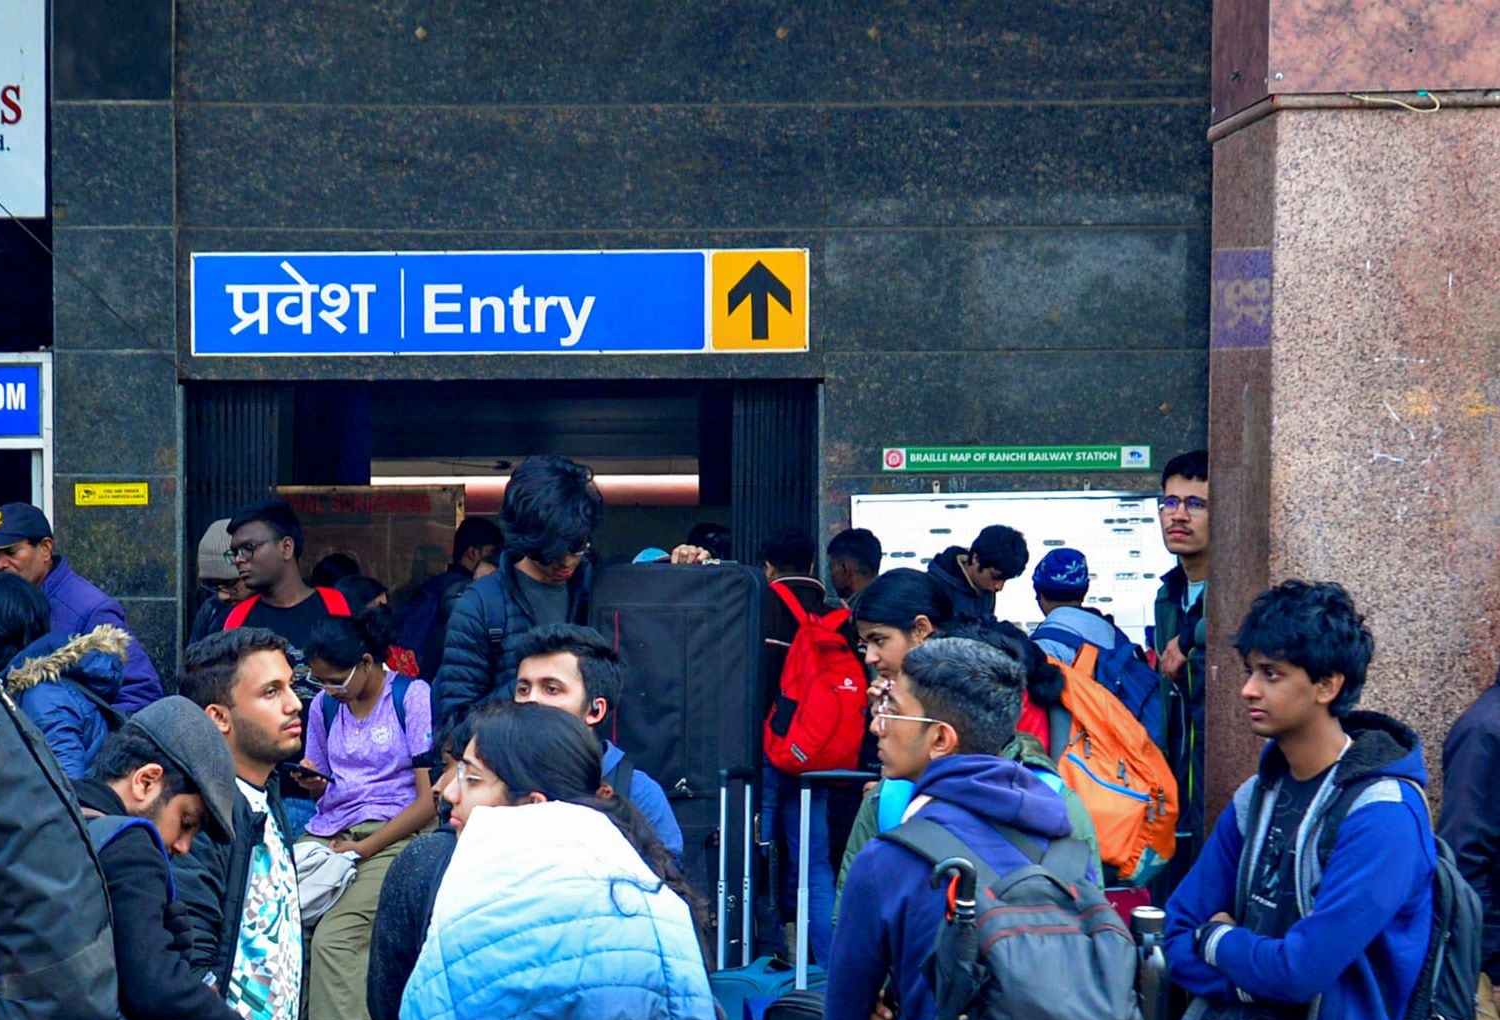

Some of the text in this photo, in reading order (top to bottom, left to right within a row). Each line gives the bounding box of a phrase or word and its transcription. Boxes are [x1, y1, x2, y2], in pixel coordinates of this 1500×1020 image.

[226, 261, 377, 335] प्रवेश
[423, 283, 596, 346] Entry
[910, 451, 1118, 463] BRAILLE MAP OF RANCHI RAILWAY STATION
